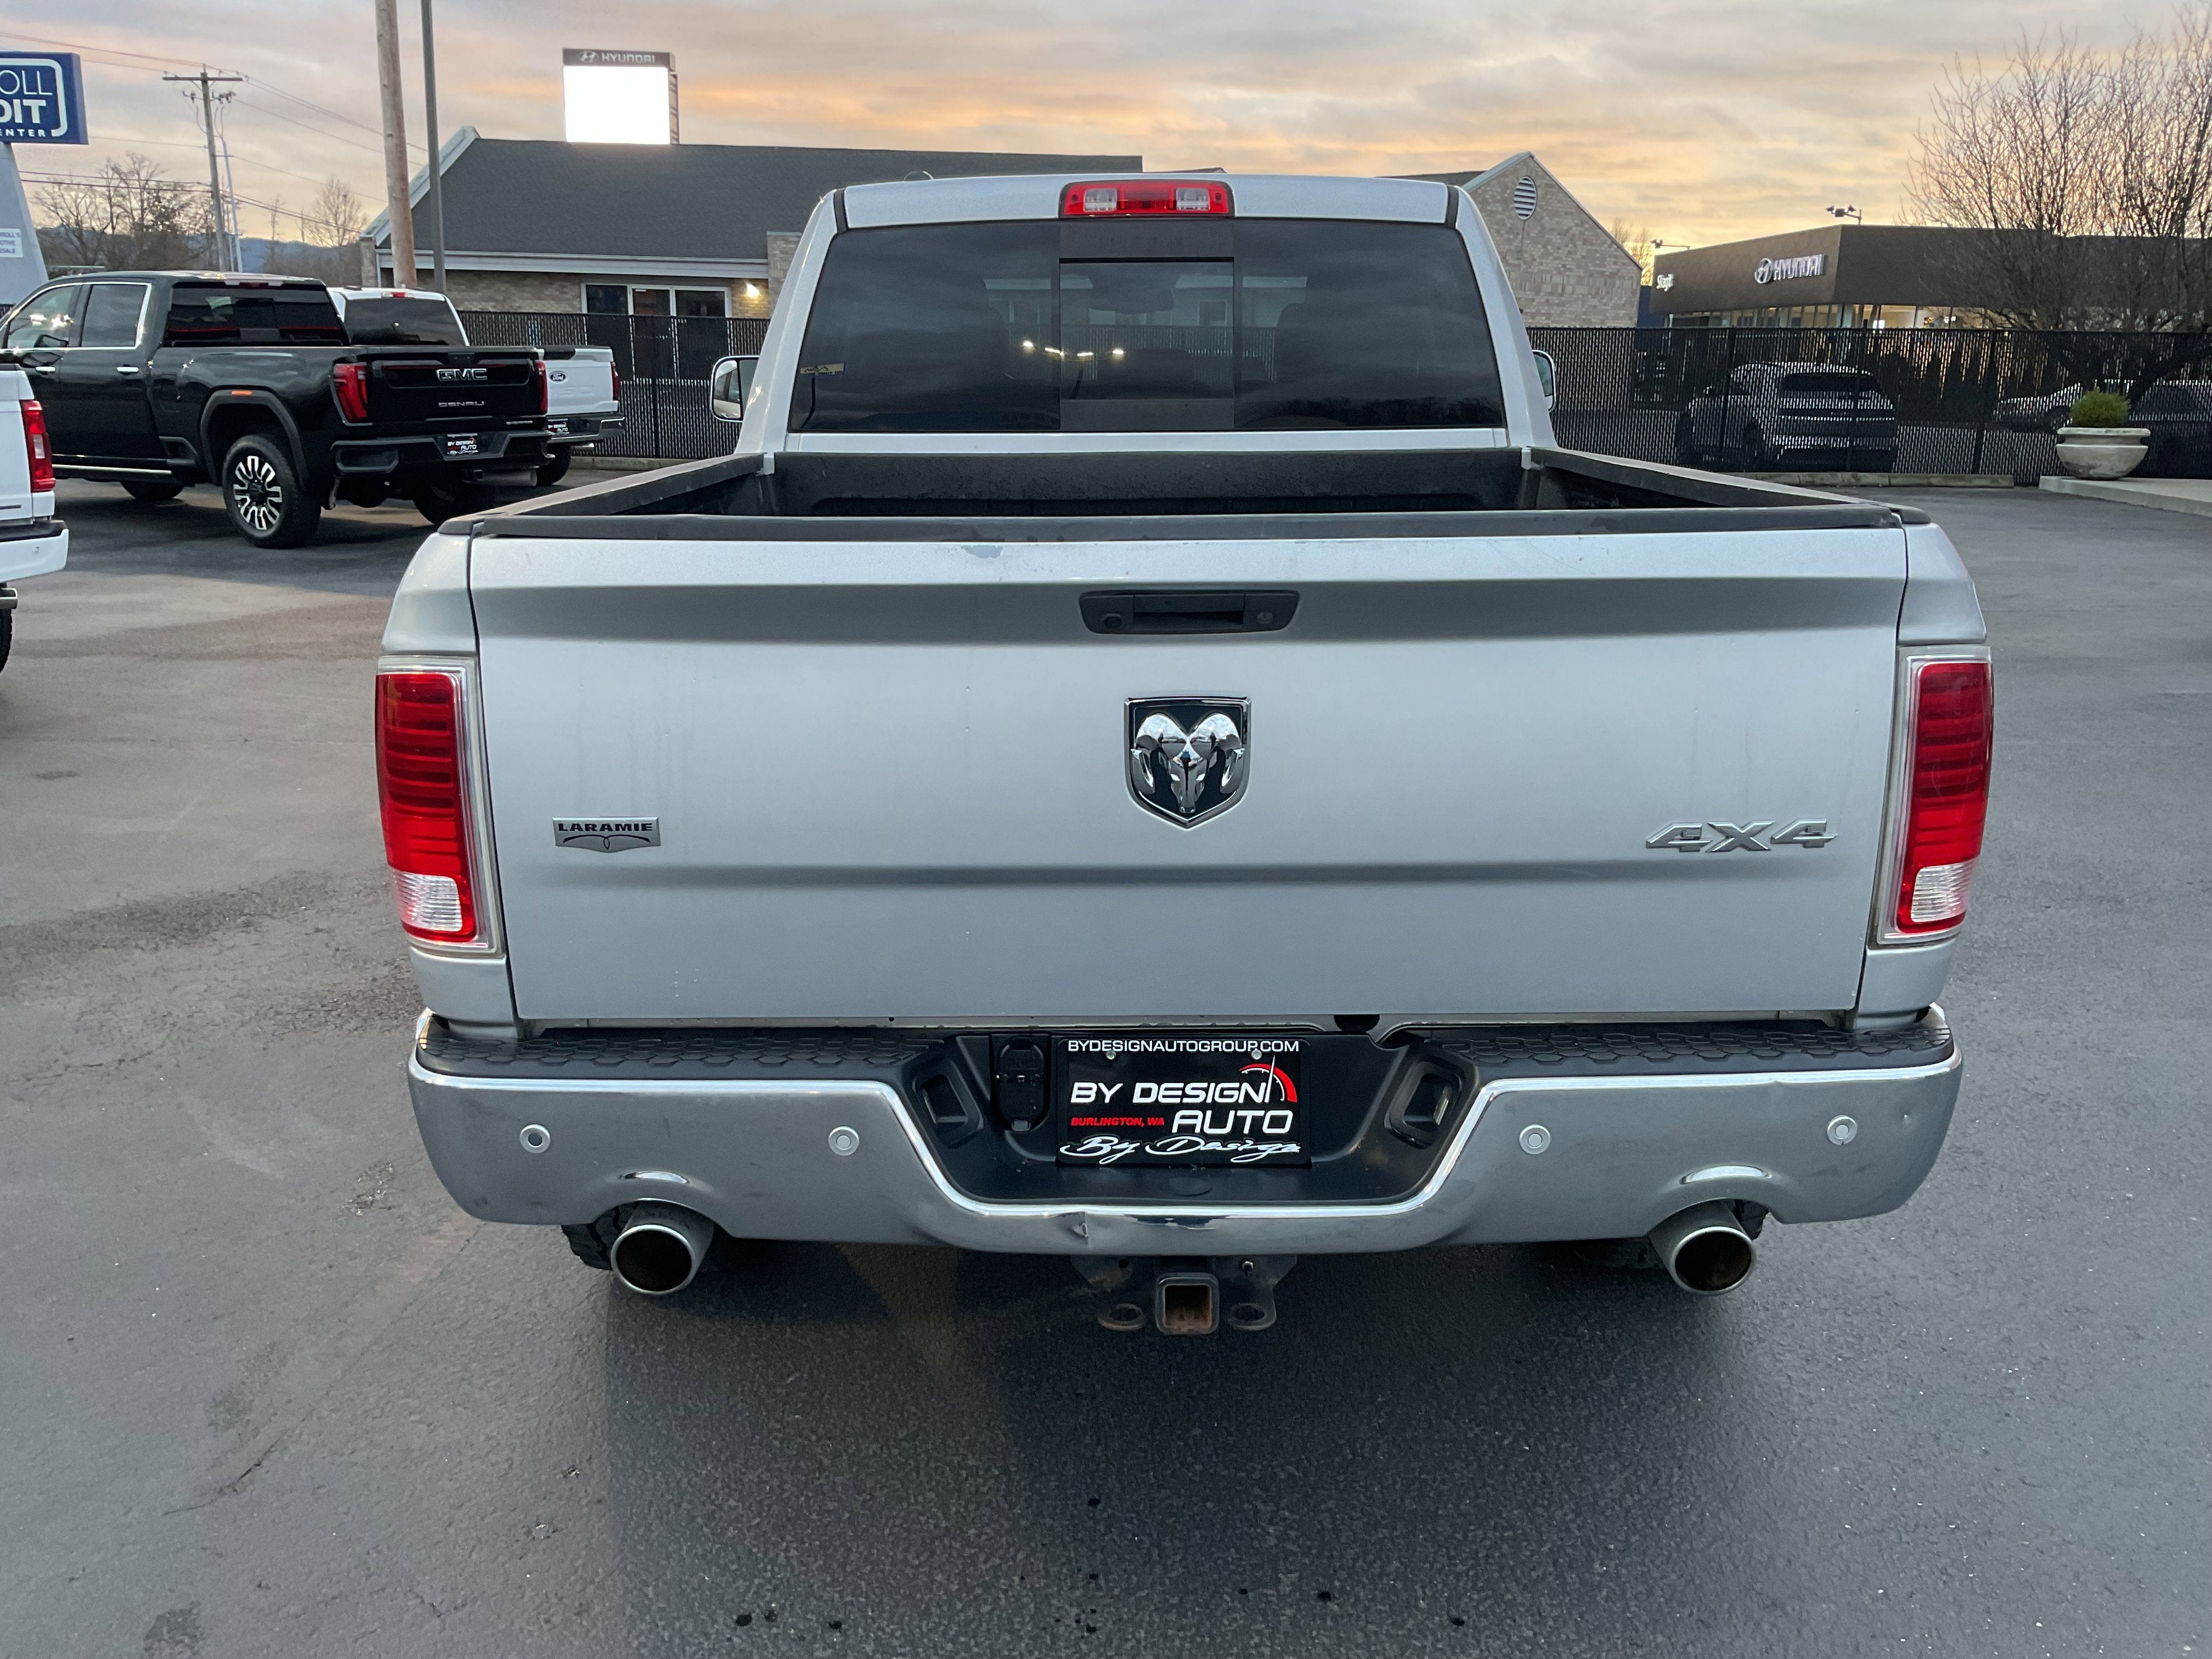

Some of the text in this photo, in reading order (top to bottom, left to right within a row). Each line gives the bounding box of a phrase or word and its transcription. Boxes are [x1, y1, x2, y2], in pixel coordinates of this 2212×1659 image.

[601, 53, 655, 64] HYUNDAI
[1773, 254, 1824, 280] HYUNDAI
[436, 368, 487, 381] GMC
[1068, 1040, 1299, 1052] BYDESIGNAUTOGROUP.COM
[1070, 1082, 1270, 1103] BY DESIGN
[1071, 1117, 1165, 1127] BURLINGTON, WA
[1171, 1110, 1293, 1134] AUTO
